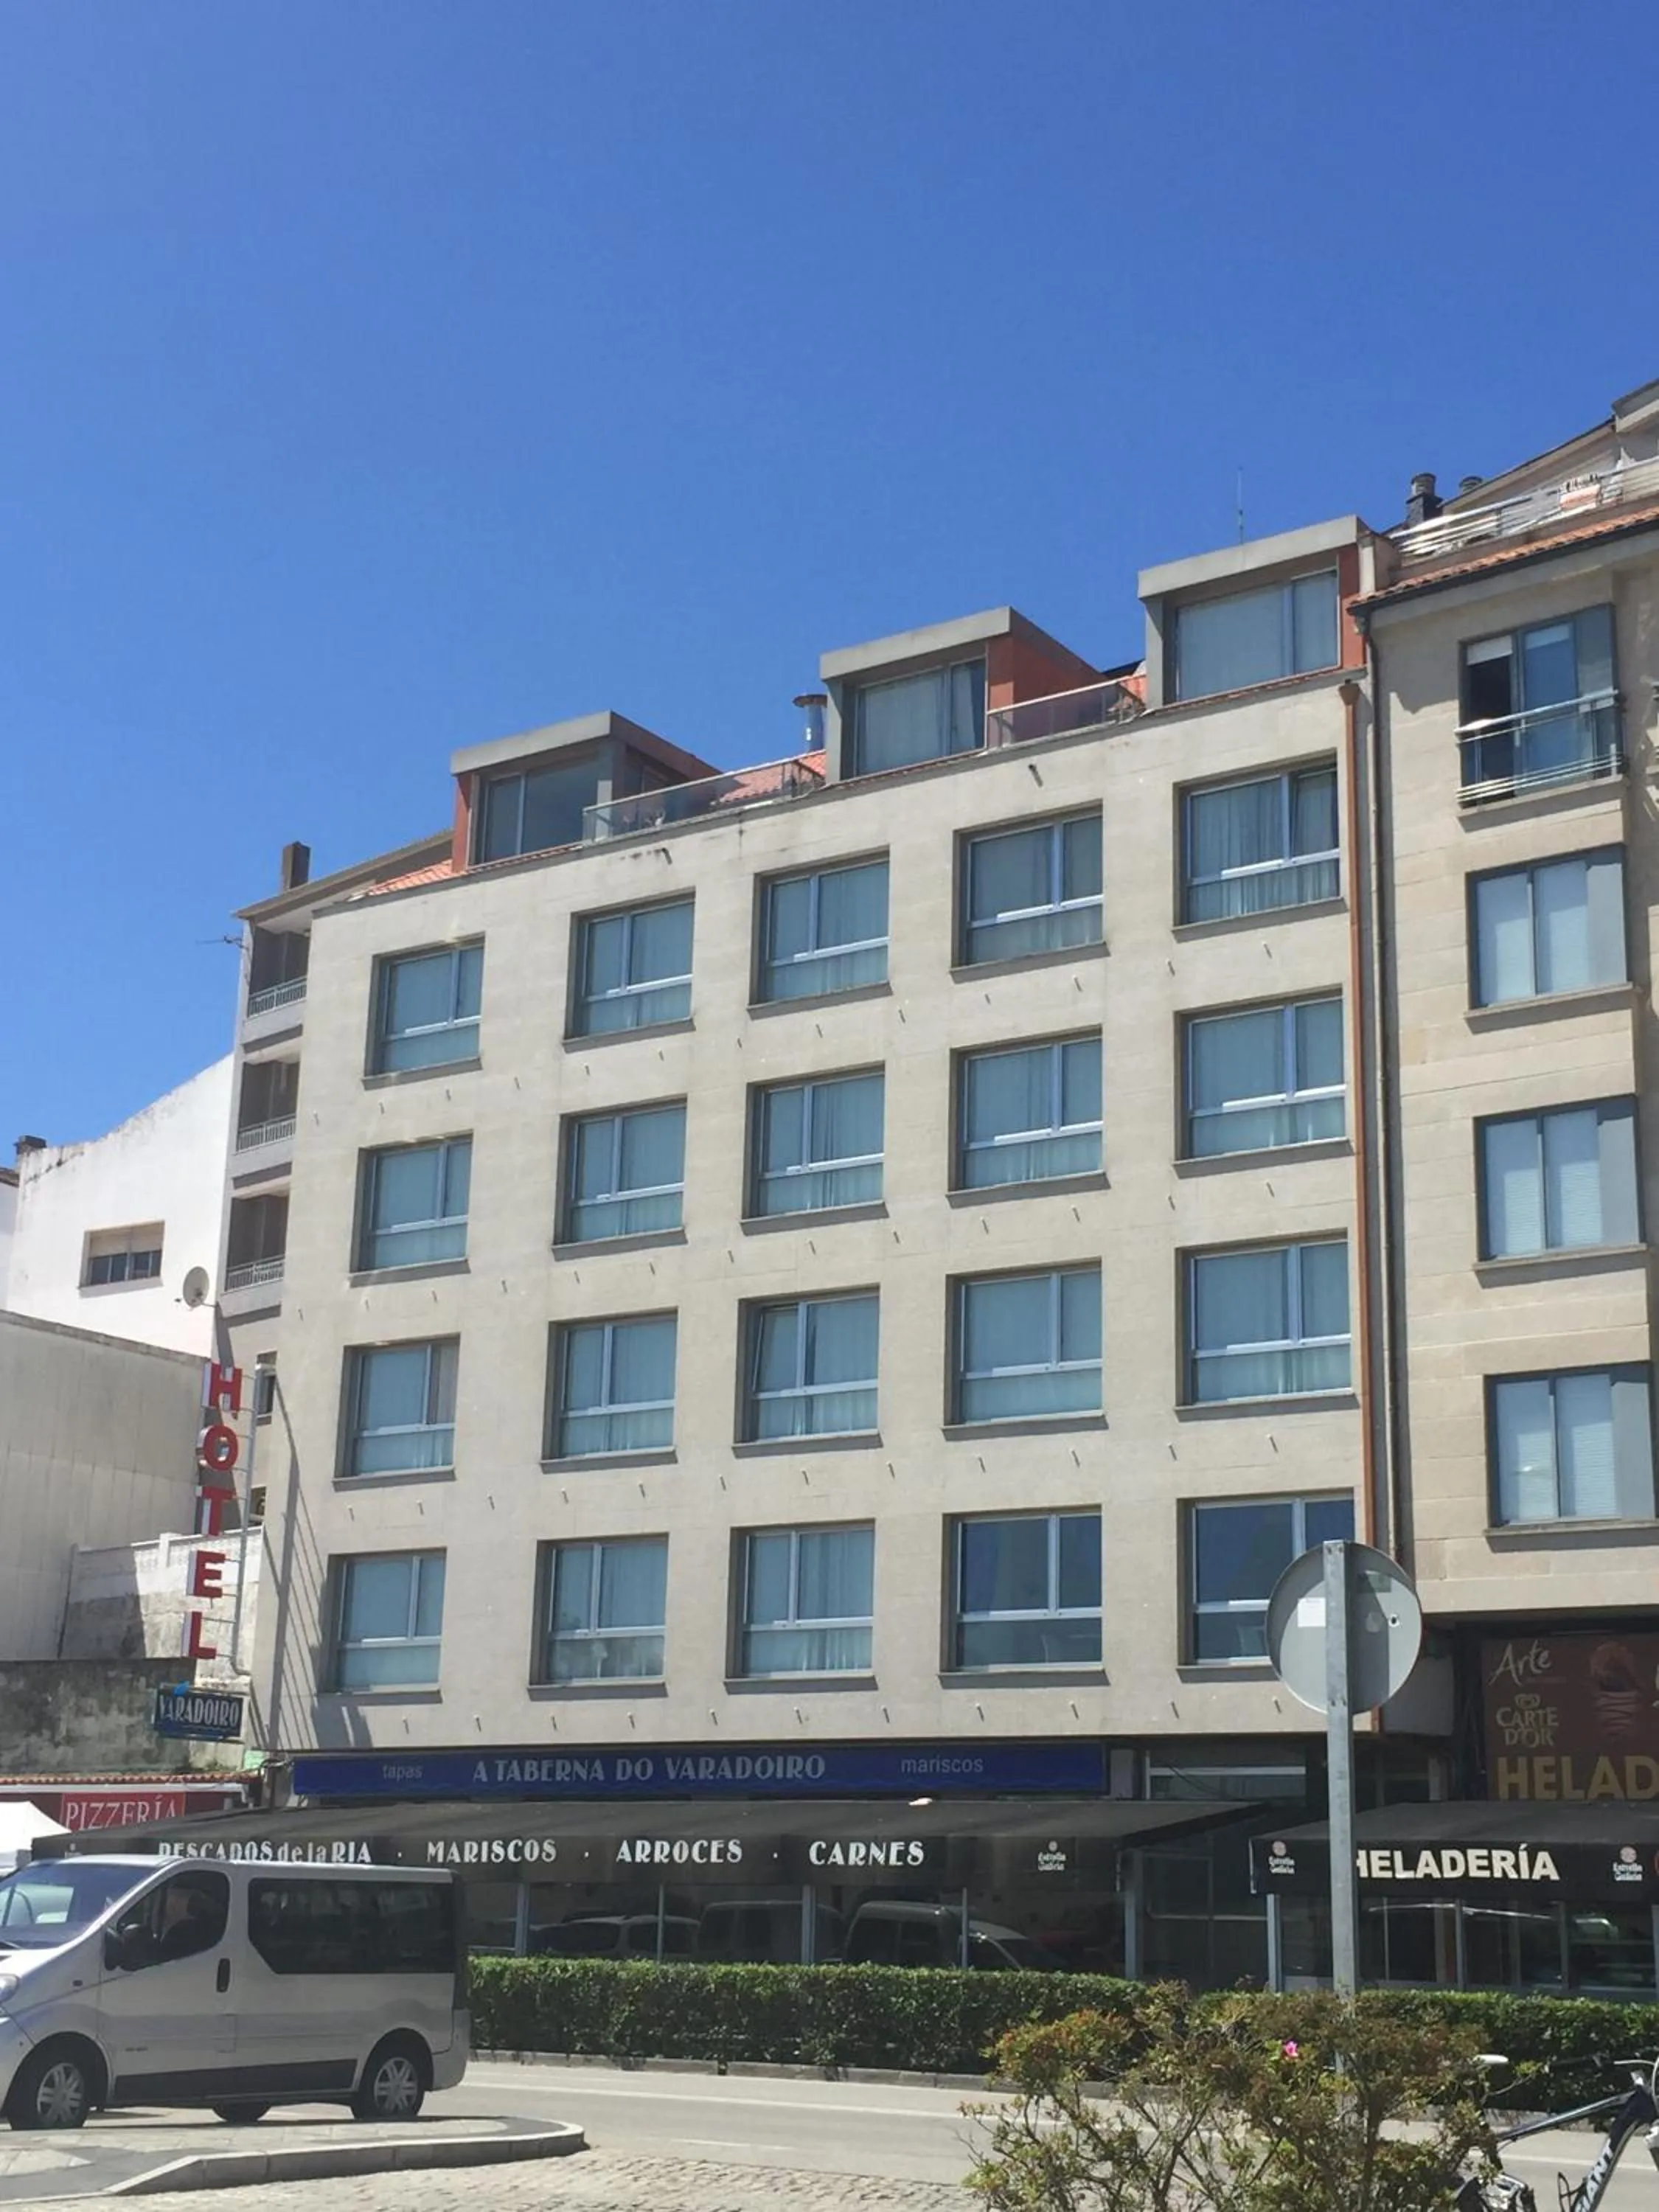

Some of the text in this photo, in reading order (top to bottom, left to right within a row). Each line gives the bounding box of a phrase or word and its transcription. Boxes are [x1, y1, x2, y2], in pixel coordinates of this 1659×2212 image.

[181, 1362, 243, 1660] HOTEL
[1487, 1639, 1551, 1686] Arte
[159, 1694, 240, 1727] VARADOIRO
[1495, 1706, 1559, 1728] CARTE
[383, 1763, 423, 1781] tapas
[473, 1755, 825, 1782] A TABERNA DO VARADOIRO
[901, 1755, 984, 1774] mariscos
[1497, 1755, 1659, 1799] HELAD
[66, 1795, 177, 1830] PIZZERÍA
[157, 1840, 273, 1863] PESCADOS
[332, 1841, 372, 1864] RIA
[427, 1840, 557, 1863] MARISCOS
[616, 1840, 742, 1863] ARROCES
[810, 1841, 925, 1866] CARNES
